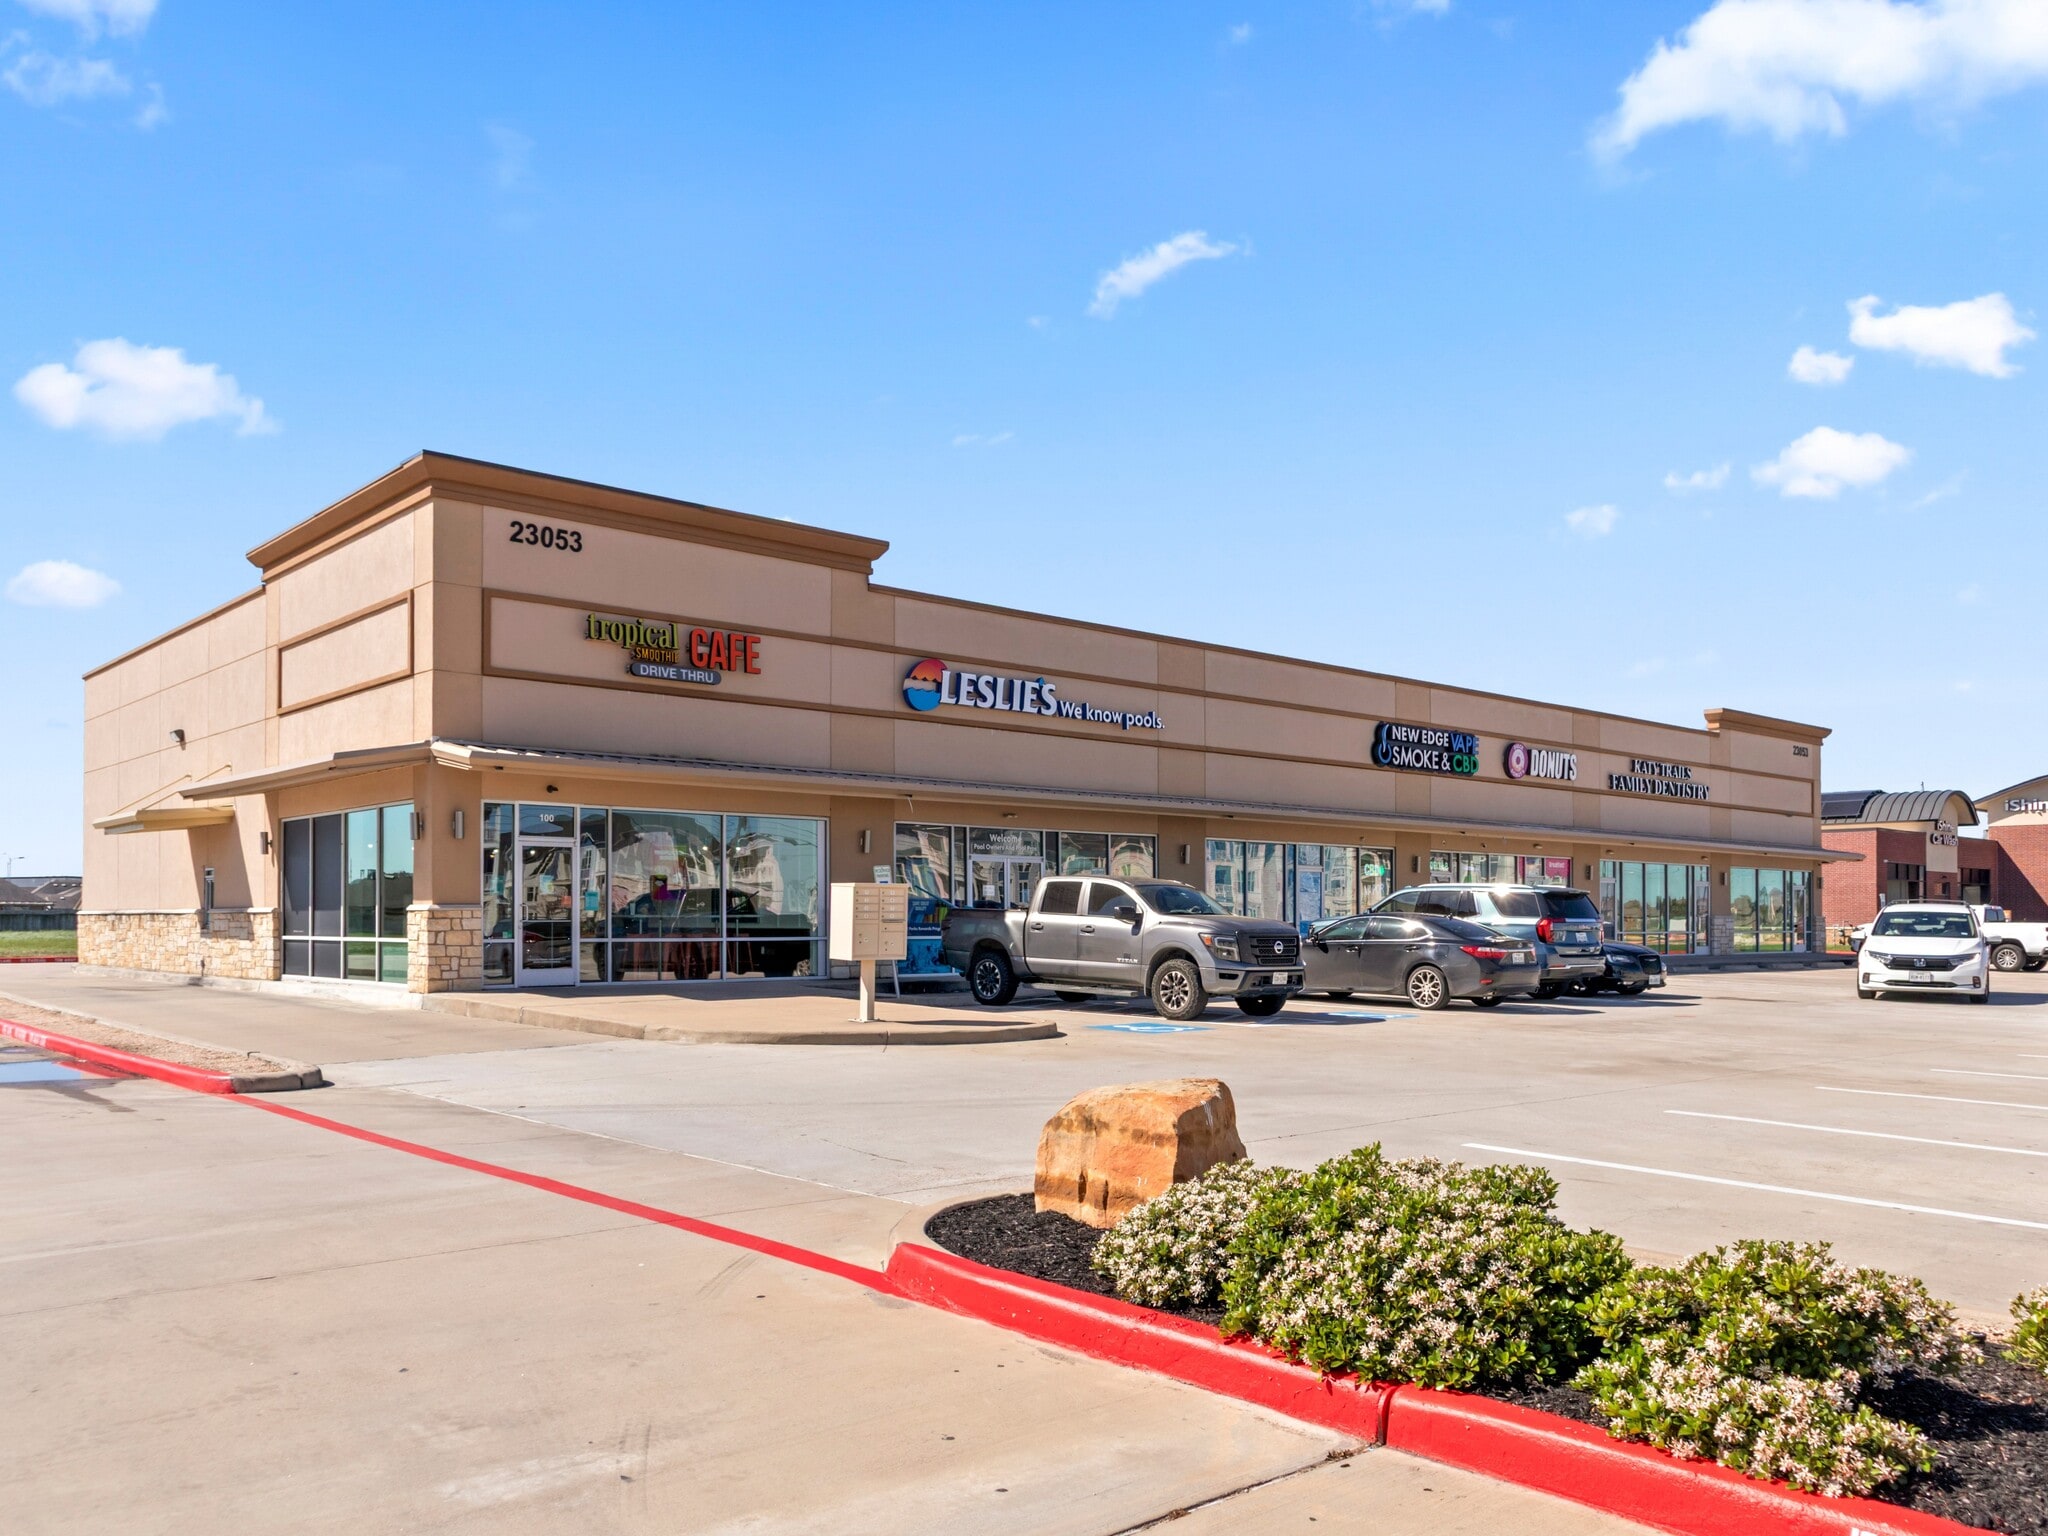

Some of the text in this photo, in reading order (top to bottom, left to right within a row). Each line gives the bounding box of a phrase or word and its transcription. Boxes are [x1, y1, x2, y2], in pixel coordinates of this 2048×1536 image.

[509, 520, 583, 553] 23053
[586, 612, 680, 650] tropical
[635, 647, 679, 664] SMOOTHIE
[690, 628, 762, 675] CAFE
[639, 664, 714, 684] DRIVE THRU
[940, 670, 1058, 716] LESLIE'S
[1060, 701, 1166, 730] We know pools.
[1391, 725, 1480, 756] NEW EDGE VAPE
[1392, 746, 1480, 774] SMOKE & CBD
[1530, 749, 1578, 781] DONUTS
[1633, 759, 1692, 780] KATY TRAILS
[1612, 774, 1710, 800] FAMILY DENTISTRY
[539, 814, 555, 823] 100
[2004, 798, 2048, 812] iShin
